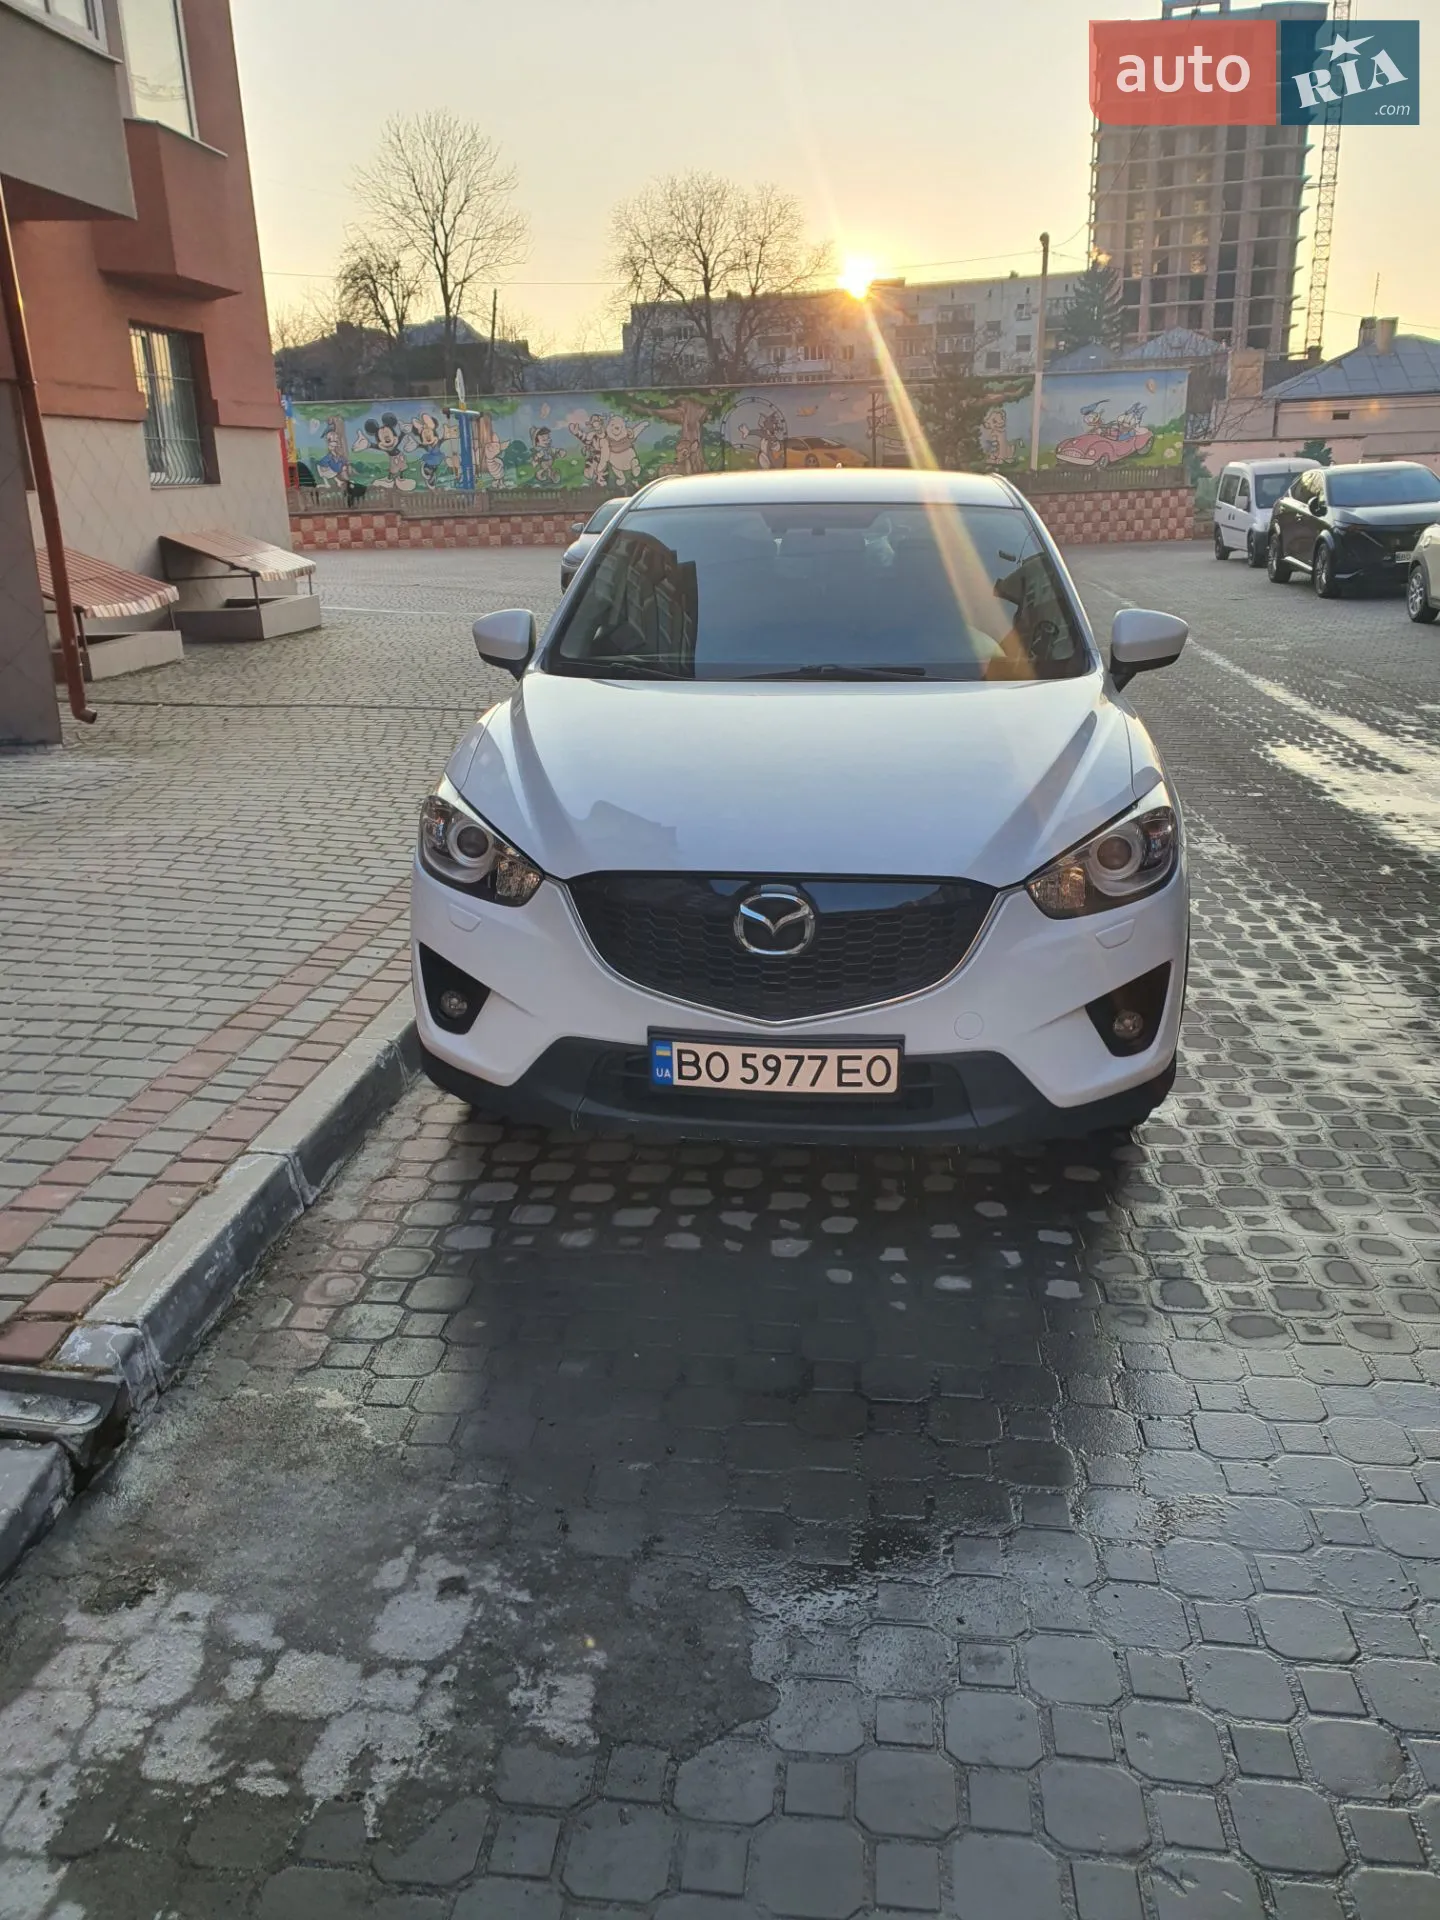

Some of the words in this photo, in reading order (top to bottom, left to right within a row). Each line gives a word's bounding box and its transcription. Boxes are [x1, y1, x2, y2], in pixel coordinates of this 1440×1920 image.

[655, 1067, 672, 1078] UA
[677, 1049, 729, 1082] BO
[740, 1053, 828, 1087] 5977
[837, 1055, 892, 1087] EO
